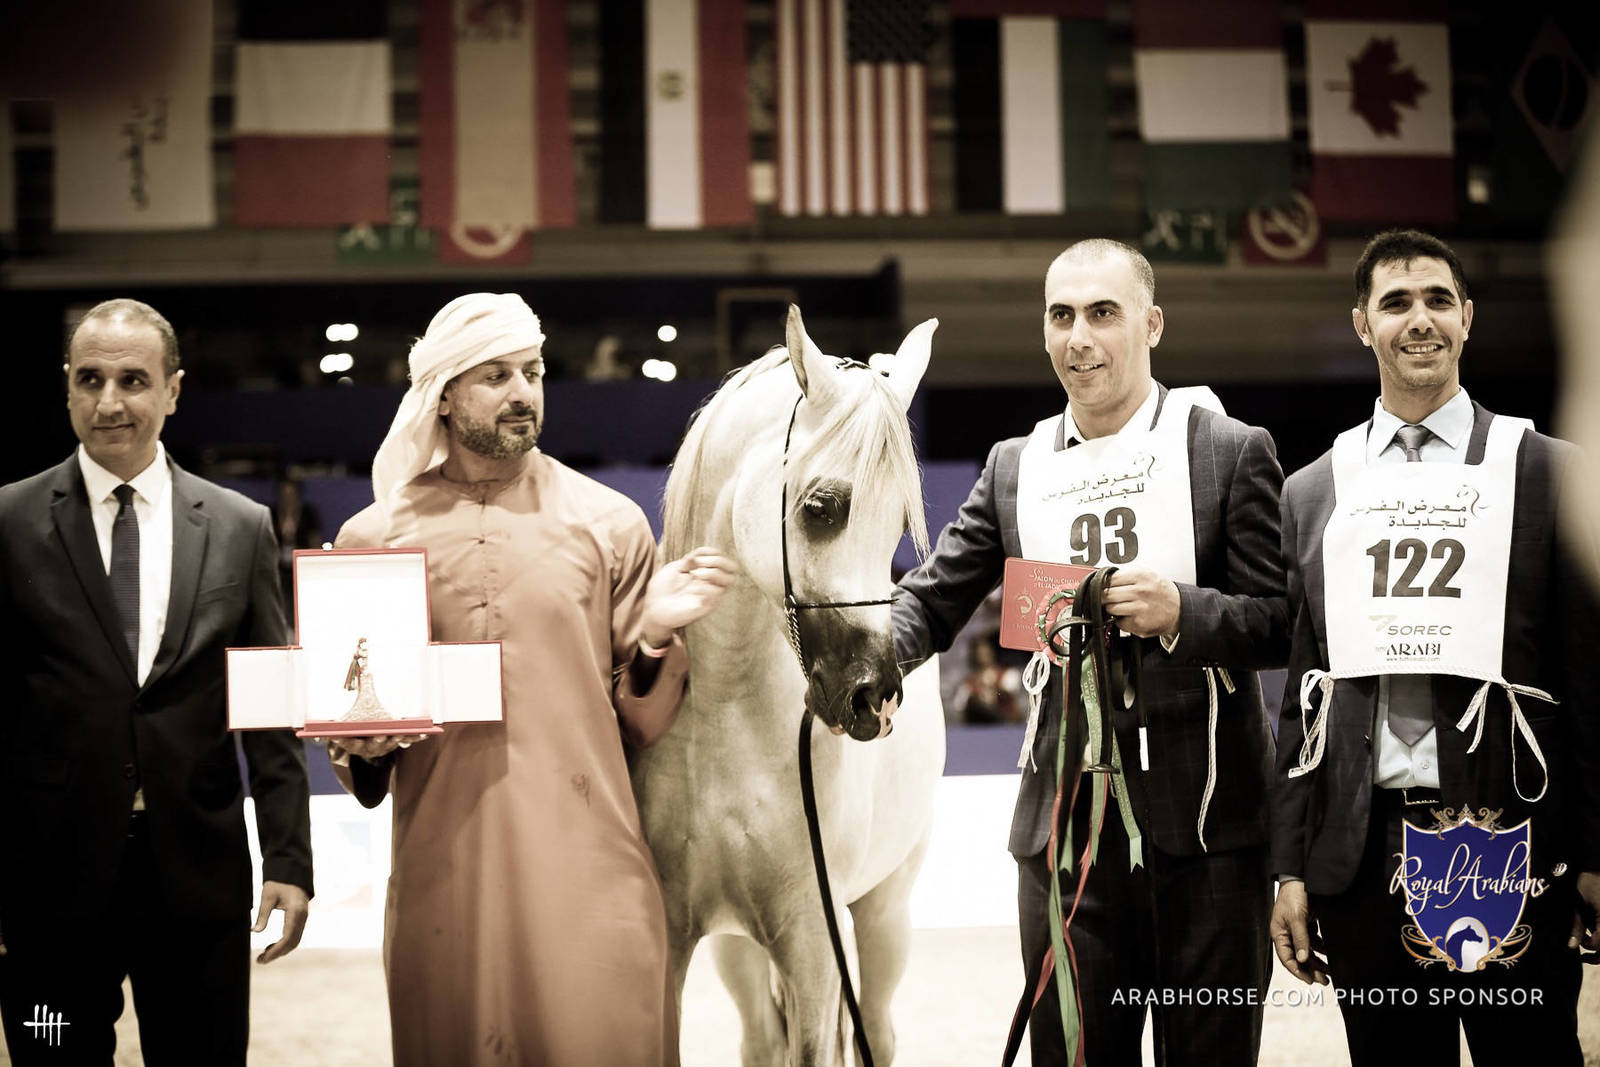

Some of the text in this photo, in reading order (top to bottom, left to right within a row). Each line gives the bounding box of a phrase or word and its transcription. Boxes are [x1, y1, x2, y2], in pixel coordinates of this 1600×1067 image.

[1092, 471, 1144, 490] معرض
[1407, 499, 1467, 515] معرض
[1388, 515, 1467, 531] للجديدة
[1069, 506, 1139, 567] 93
[1366, 537, 1466, 599] 122
[1387, 625, 1453, 636] SOREC
[1386, 642, 1441, 656] ARABI
